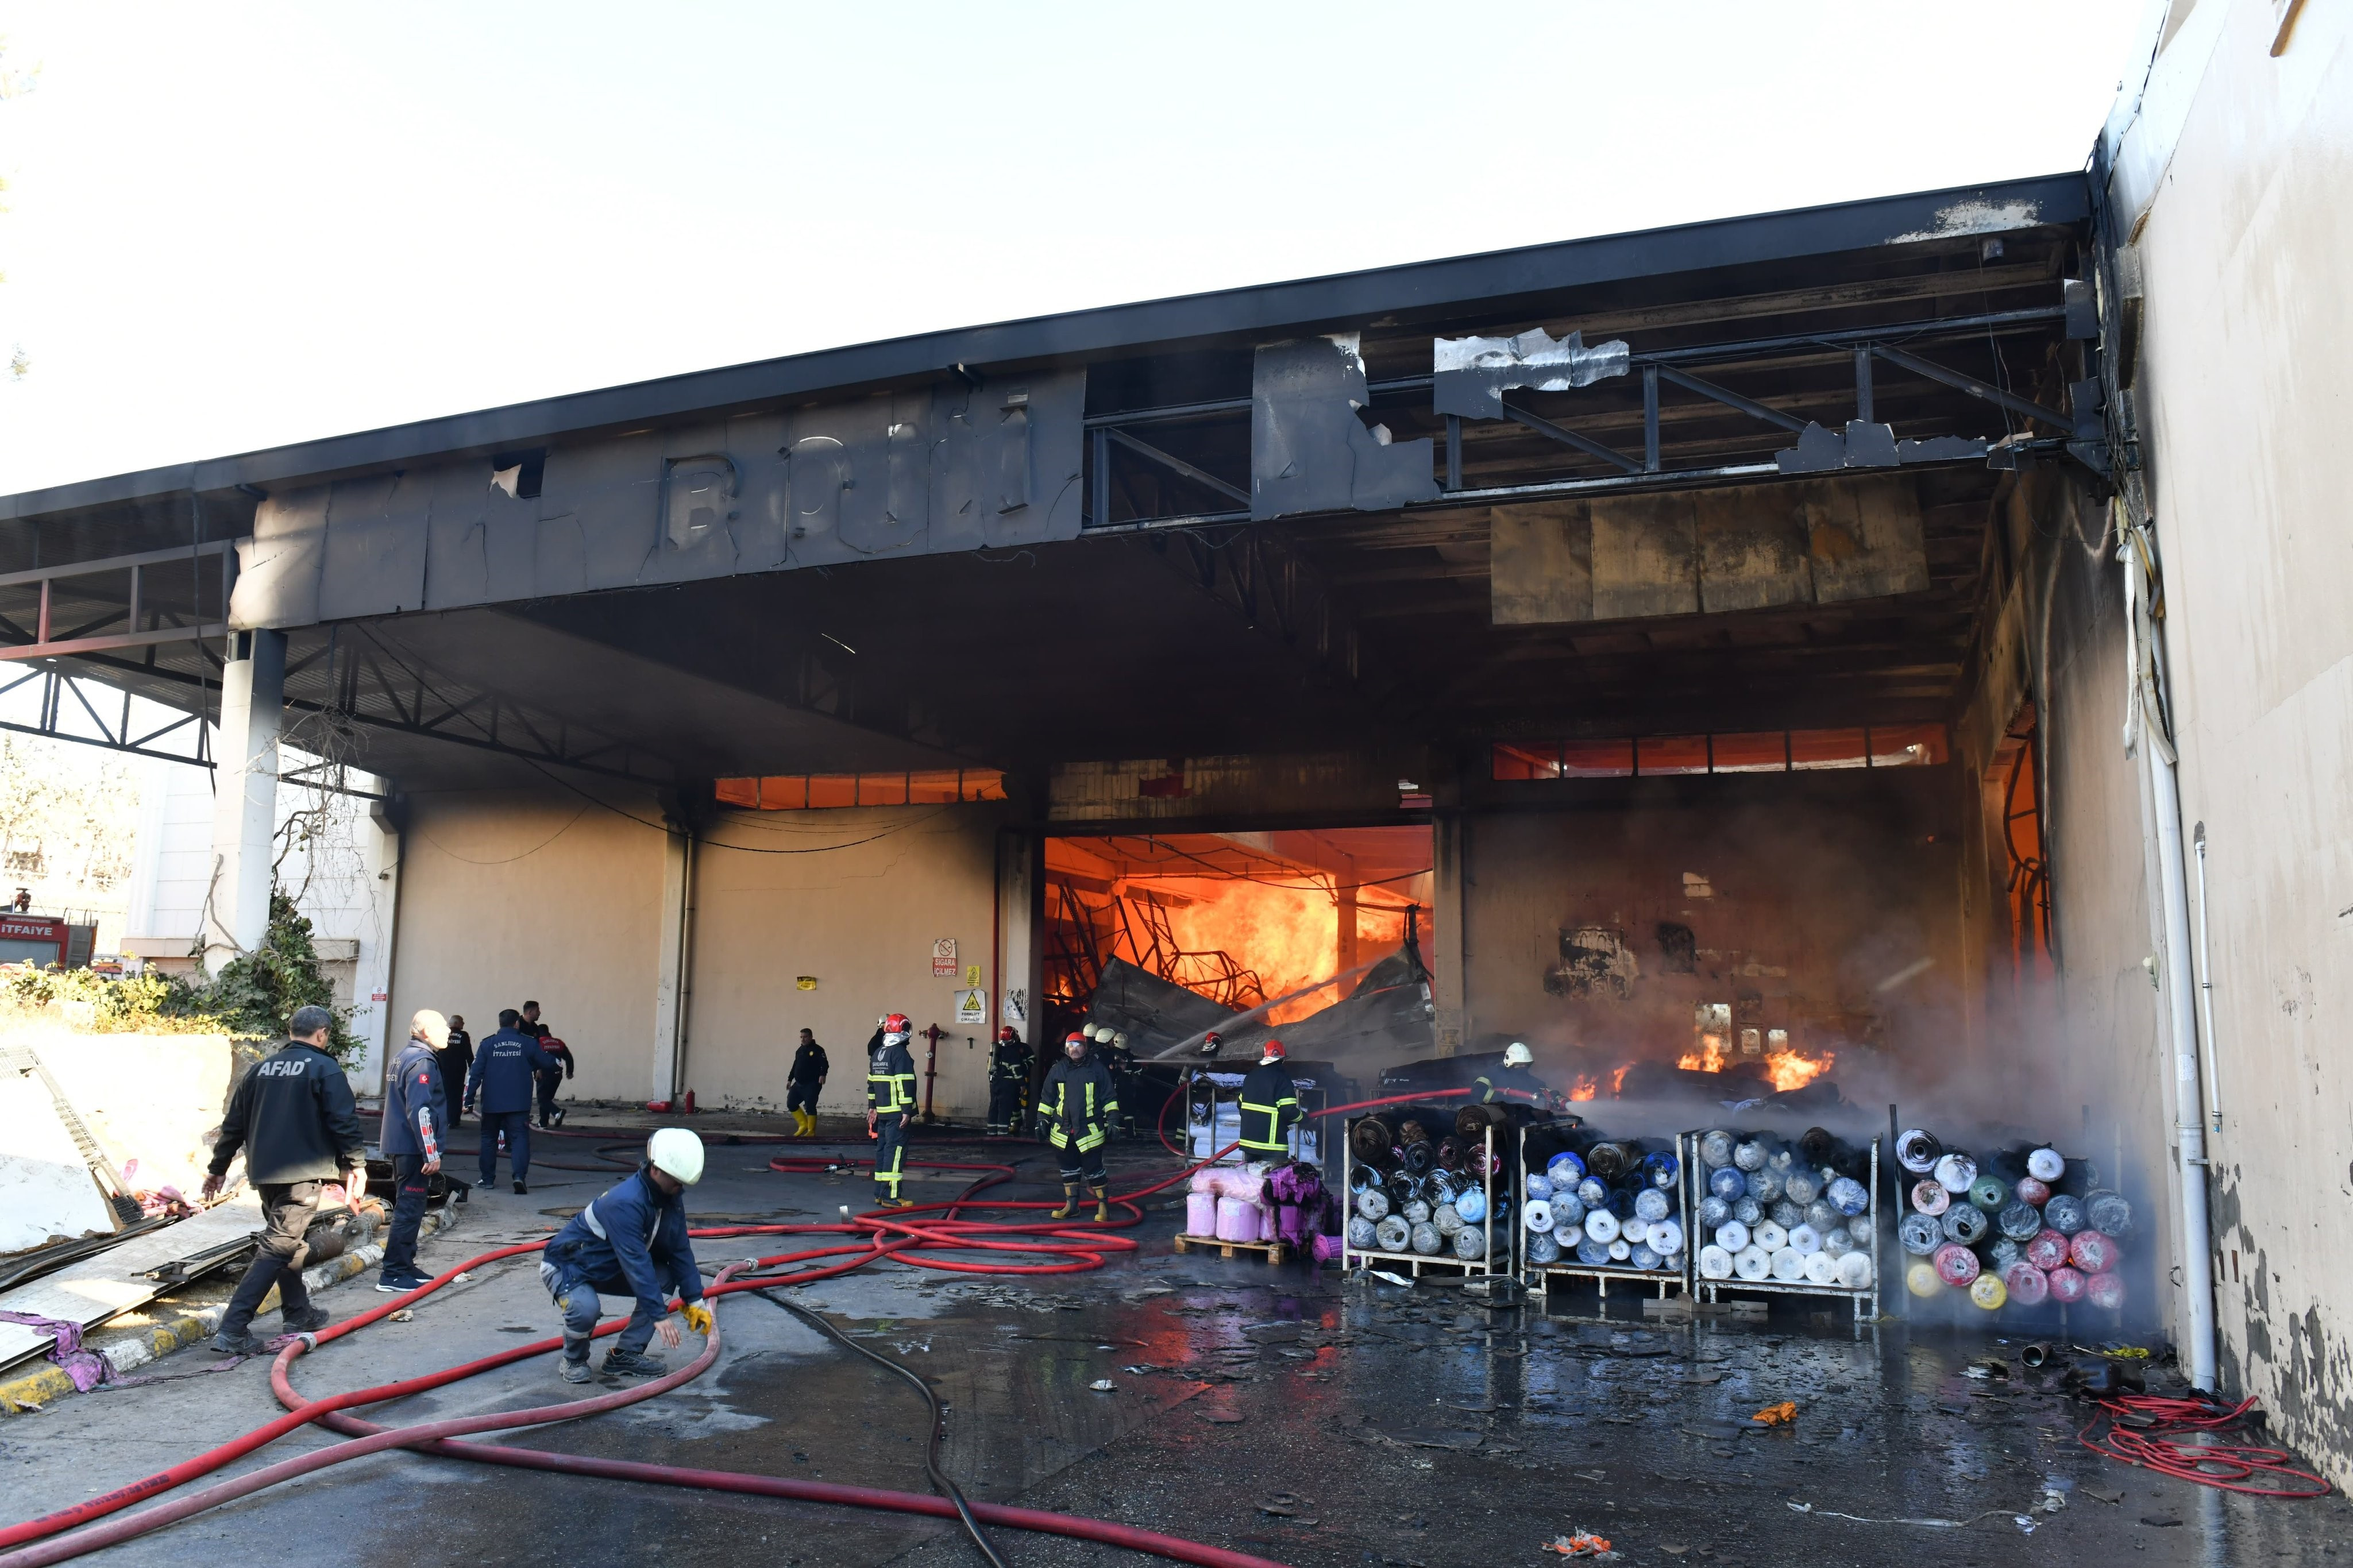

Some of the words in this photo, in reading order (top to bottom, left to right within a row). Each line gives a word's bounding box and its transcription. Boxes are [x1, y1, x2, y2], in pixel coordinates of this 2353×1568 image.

[935, 958, 955, 966] SİGARA
[934, 968, 956, 976] İÇİLMEZ
[257, 1061, 305, 1076] AFAD
